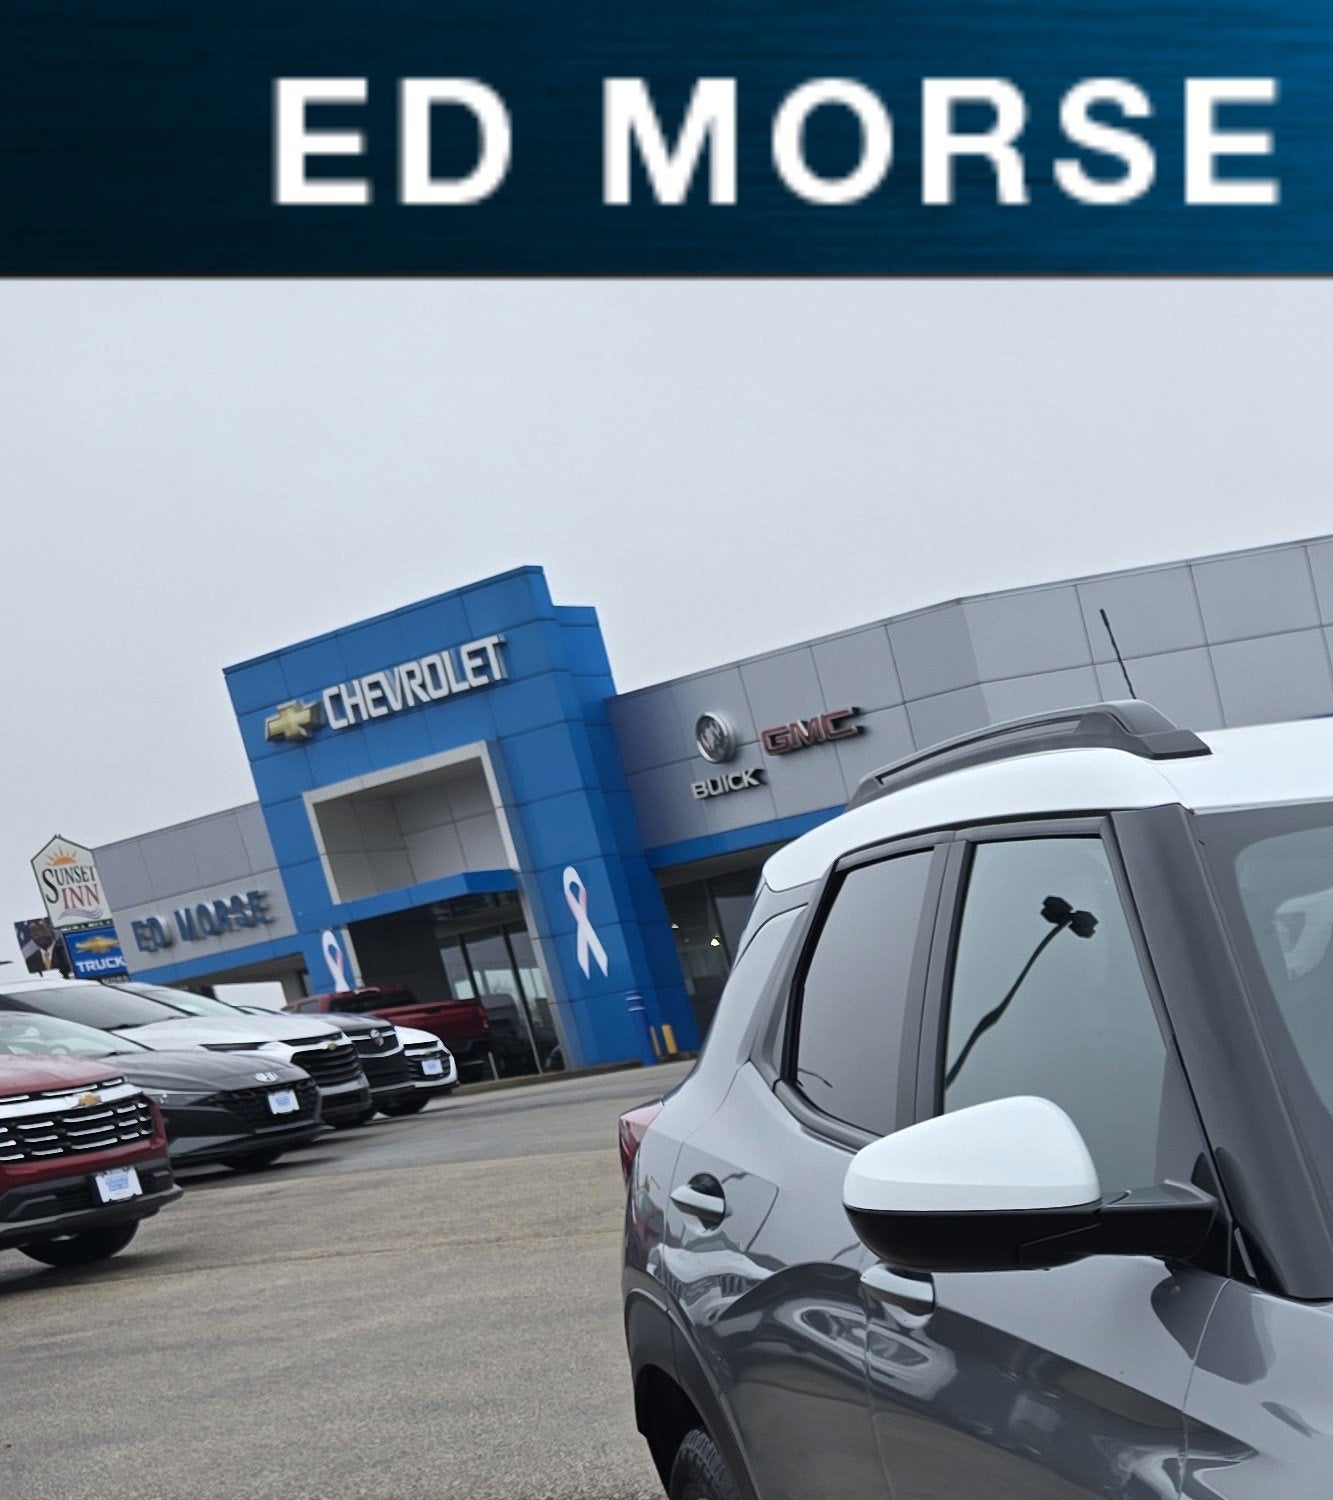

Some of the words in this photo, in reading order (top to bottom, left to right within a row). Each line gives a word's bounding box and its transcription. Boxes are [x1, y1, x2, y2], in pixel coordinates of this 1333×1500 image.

[323, 634, 506, 730] CHEVROLET
[761, 708, 862, 756] GMC
[691, 769, 761, 800] BUICK
[42, 865, 96, 904] SUNSET
[62, 884, 100, 910] INN
[131, 917, 169, 952] ED
[174, 891, 272, 941] MORSE
[76, 956, 126, 973] TRUCK
